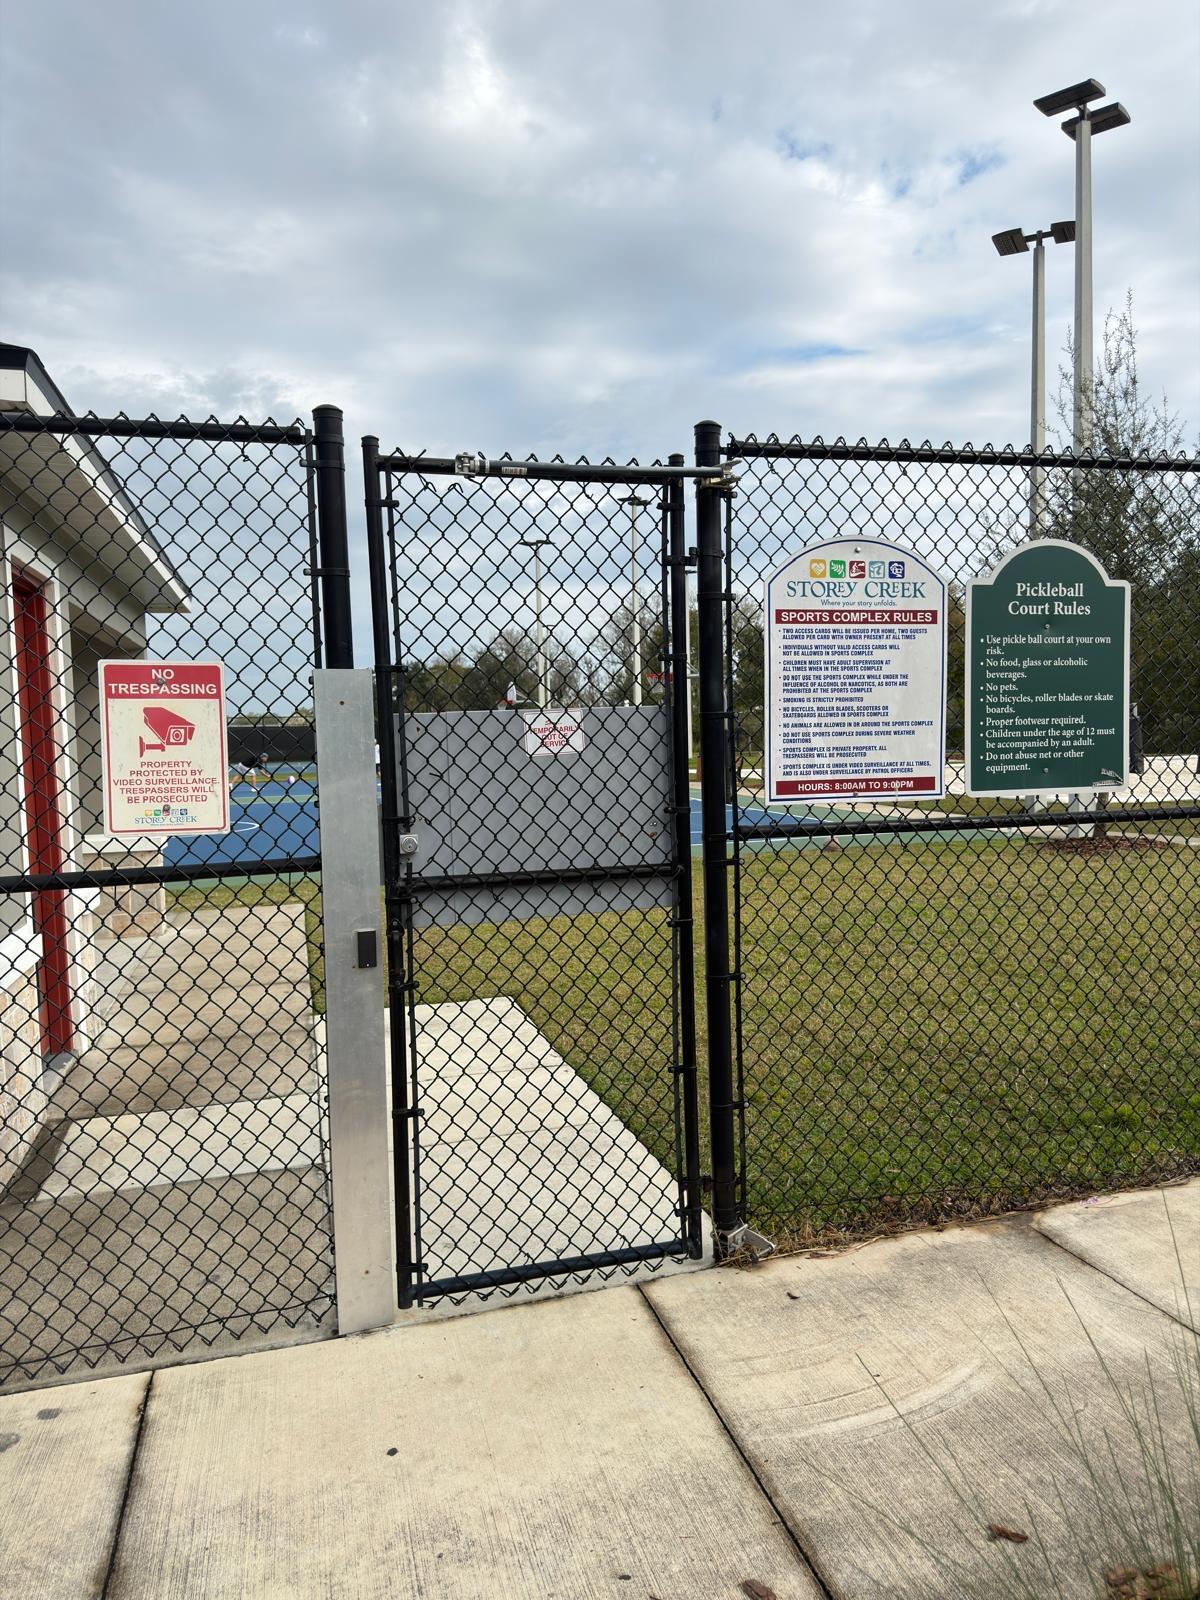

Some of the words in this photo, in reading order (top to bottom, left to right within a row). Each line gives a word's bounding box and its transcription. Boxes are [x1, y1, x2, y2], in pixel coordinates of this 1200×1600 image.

[786, 580, 856, 598] STOREY
[864, 581, 926, 599] CREEK
[1015, 582, 1083, 597] Pickleball
[874, 599, 897, 607] unfolds.
[1008, 601, 1049, 615] Court
[1054, 601, 1091, 615] Rules
[781, 612, 829, 621] SPORTS
[833, 612, 890, 621] COMPLEX
[893, 612, 932, 621] RULES
[986, 635, 1001, 644] Use
[1002, 635, 1026, 646] pickle
[1027, 635, 1042, 644] ball
[1044, 635, 1065, 644] court
[1067, 635, 1074, 644] at
[1076, 636, 1093, 645] your
[1095, 636, 1111, 644] own
[986, 646, 1004, 655] risk.
[986, 658, 998, 667] No
[1000, 658, 1020, 667] food,
[1022, 658, 1041, 667] glass
[1053, 658, 1088, 666] alcoholic
[151, 669, 174, 680] NO
[986, 669, 1027, 681] beverages.
[109, 684, 217, 694] TRESPASSING
[986, 682, 998, 691] No
[1000, 683, 1018, 692] pets.
[986, 694, 998, 703] No
[1000, 694, 1033, 704] bicycles,
[1035, 693, 1056, 702] roller
[1058, 693, 1083, 702] blades
[1094, 693, 1113, 701] skate
[986, 705, 1015, 713] boards.
[986, 717, 1013, 727] Proper
[1015, 716, 1049, 726] footwear
[1051, 715, 1086, 725] required.
[986, 728, 1021, 738] Children
[1023, 728, 1046, 737] under
[1048, 728, 1060, 736] the
[1062, 729, 1075, 737] age
[1076, 727, 1084, 735] of
[1087, 727, 1095, 735] 12
[1097, 727, 1115, 735] must
[986, 740, 995, 749] be
[997, 739, 1049, 749] accompanied
[1050, 739, 1059, 747] by
[1062, 738, 1071, 746] an
[1073, 738, 1095, 746] adult.
[986, 752, 998, 760] Do
[1000, 752, 1013, 760] not
[1015, 750, 1037, 759] abuse
[1039, 751, 1051, 759] net
[1063, 750, 1084, 758] other
[130, 769, 187, 777] PROTECTED
[986, 763, 1030, 773] equipment.
[113, 778, 142, 786] VIDEO
[798, 782, 832, 791] HOURS:
[835, 781, 866, 790] 8:00AM
[869, 781, 880, 789] TO
[883, 780, 913, 789] 9:00PM
[127, 796, 140, 804] BE
[142, 795, 207, 803] PROSECUTED
[135, 815, 167, 824] STOREY
[169, 815, 197, 824] CREEK
